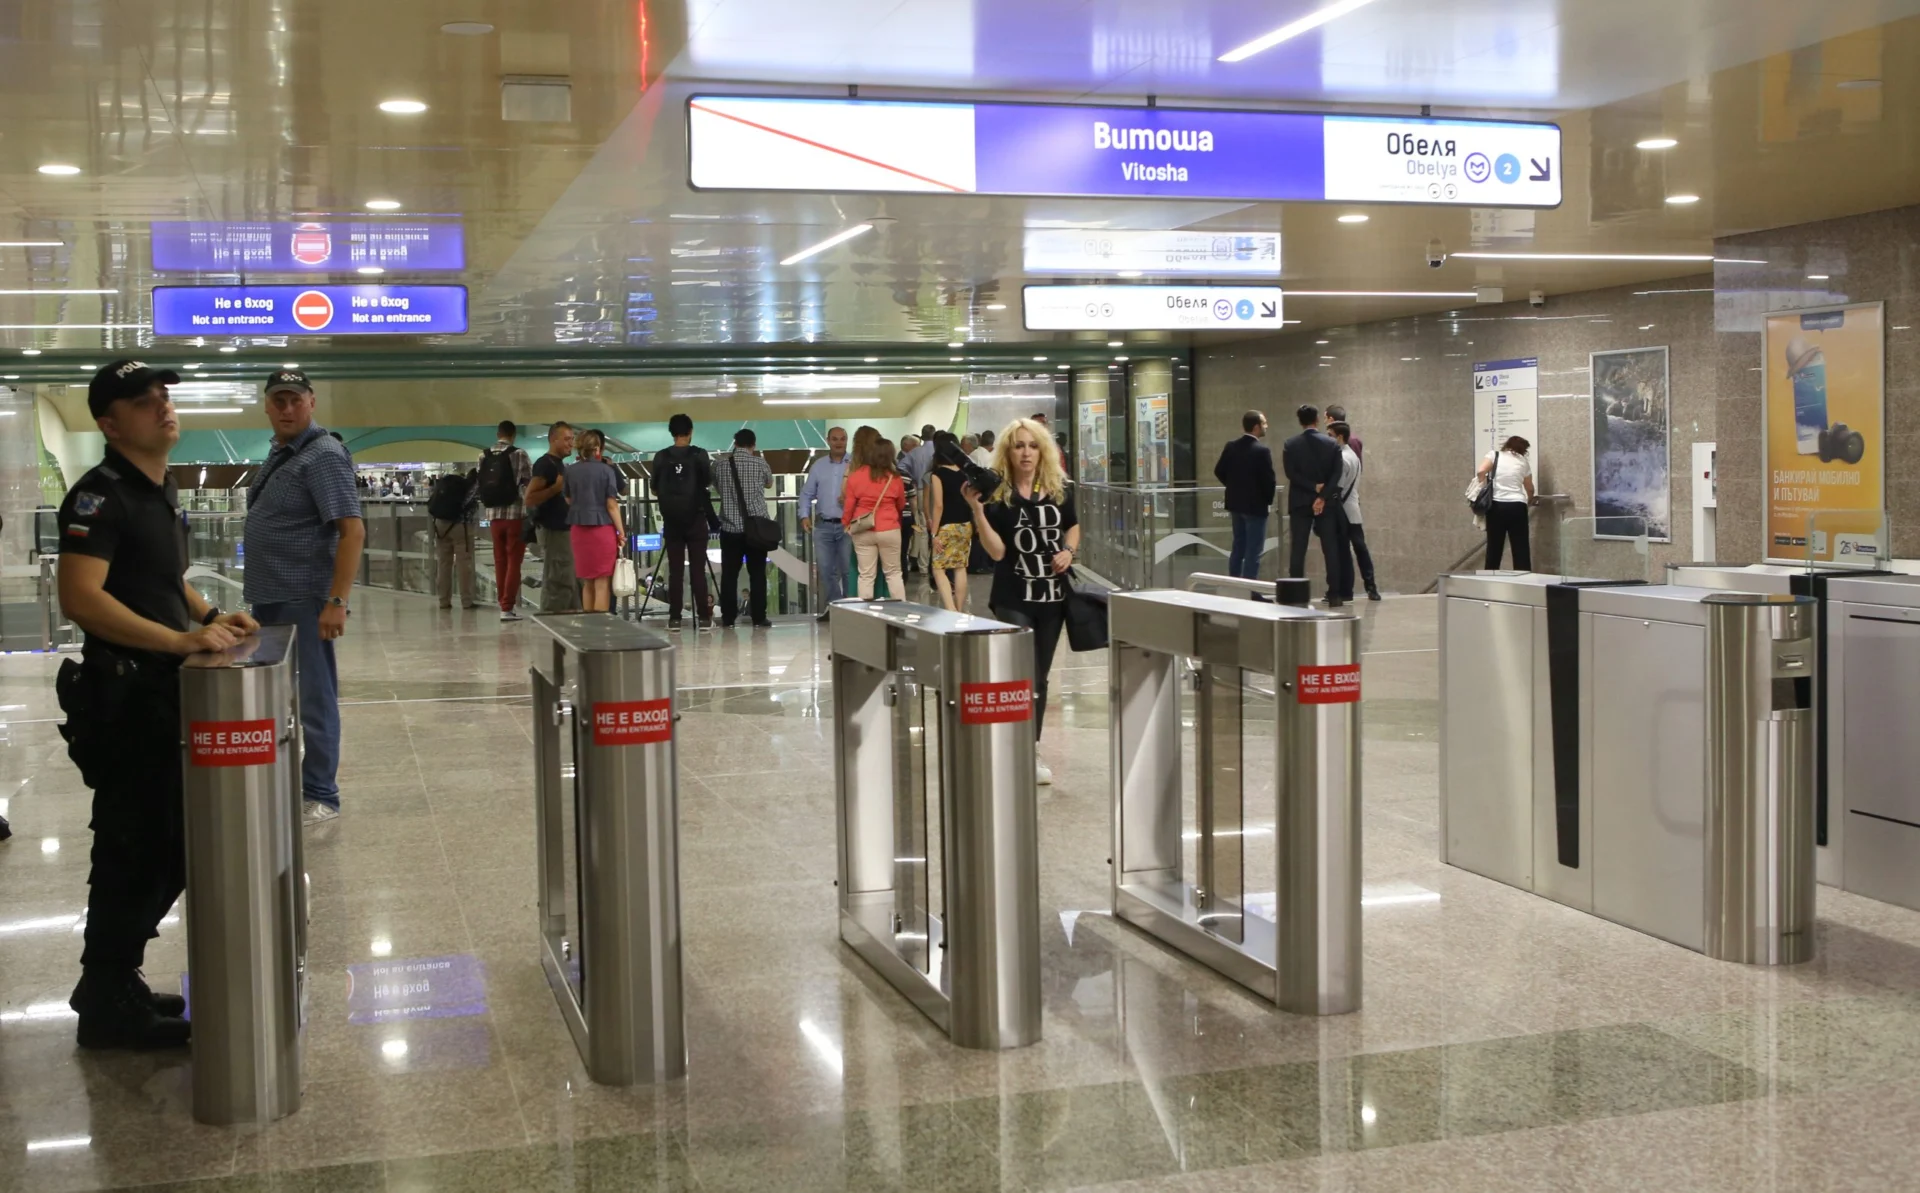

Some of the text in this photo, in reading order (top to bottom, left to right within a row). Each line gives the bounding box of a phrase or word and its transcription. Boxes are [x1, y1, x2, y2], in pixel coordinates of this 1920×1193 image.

[1094, 121, 1214, 152] Витоша
[1387, 132, 1456, 157] Обеля
[1121, 162, 1188, 182] Vitosha
[1406, 159, 1457, 179] Obelya
[1503, 163, 1512, 175] 2
[215, 297, 274, 311] Не е вход
[352, 296, 409, 310] Не е вход
[1166, 295, 1208, 309] Обеля
[1241, 306, 1249, 315] 2
[192, 315, 274, 325] Not an entrance
[352, 313, 431, 323] Not an entrance
[1773, 469, 1860, 485] БАНКИРАЙ МОБИЛНО
[1773, 486, 1819, 502] И ПЪТУВАЙ
[1301, 674, 1320, 685] НЕ
[1323, 673, 1332, 685] Е
[964, 689, 1031, 704] НЕ Е ВХОД
[596, 708, 669, 725] НЕ Е ВХОД
[616, 726, 627, 734] AN
[629, 723, 666, 733] ENTRANCE
[193, 729, 272, 745] НЕ Е ВХОД
[197, 745, 269, 755] NOT AN ENTRANCE
